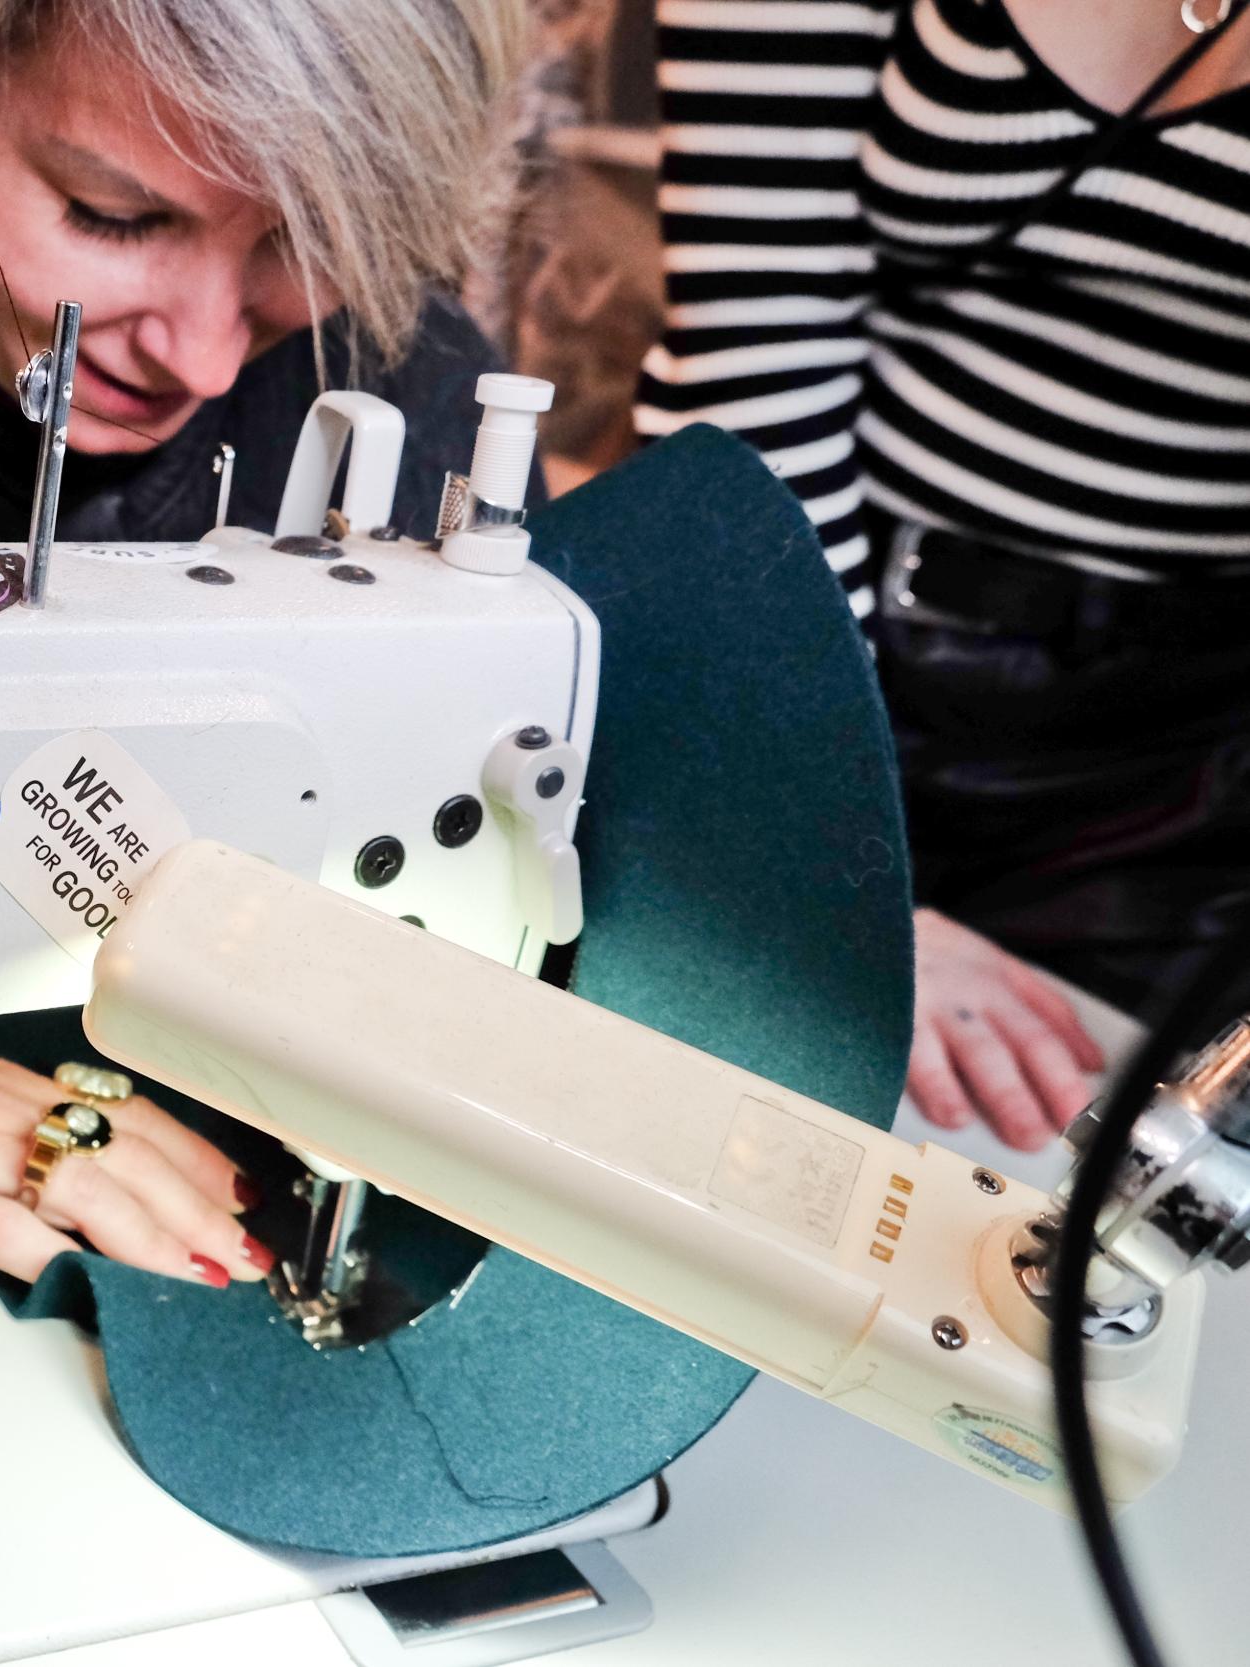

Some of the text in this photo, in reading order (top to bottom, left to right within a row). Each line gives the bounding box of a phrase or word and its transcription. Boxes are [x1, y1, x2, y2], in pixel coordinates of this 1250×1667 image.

[21, 780, 119, 883] GROWING
[25, 835, 62, 872] FOR
[62, 756, 149, 864] WE ARE
